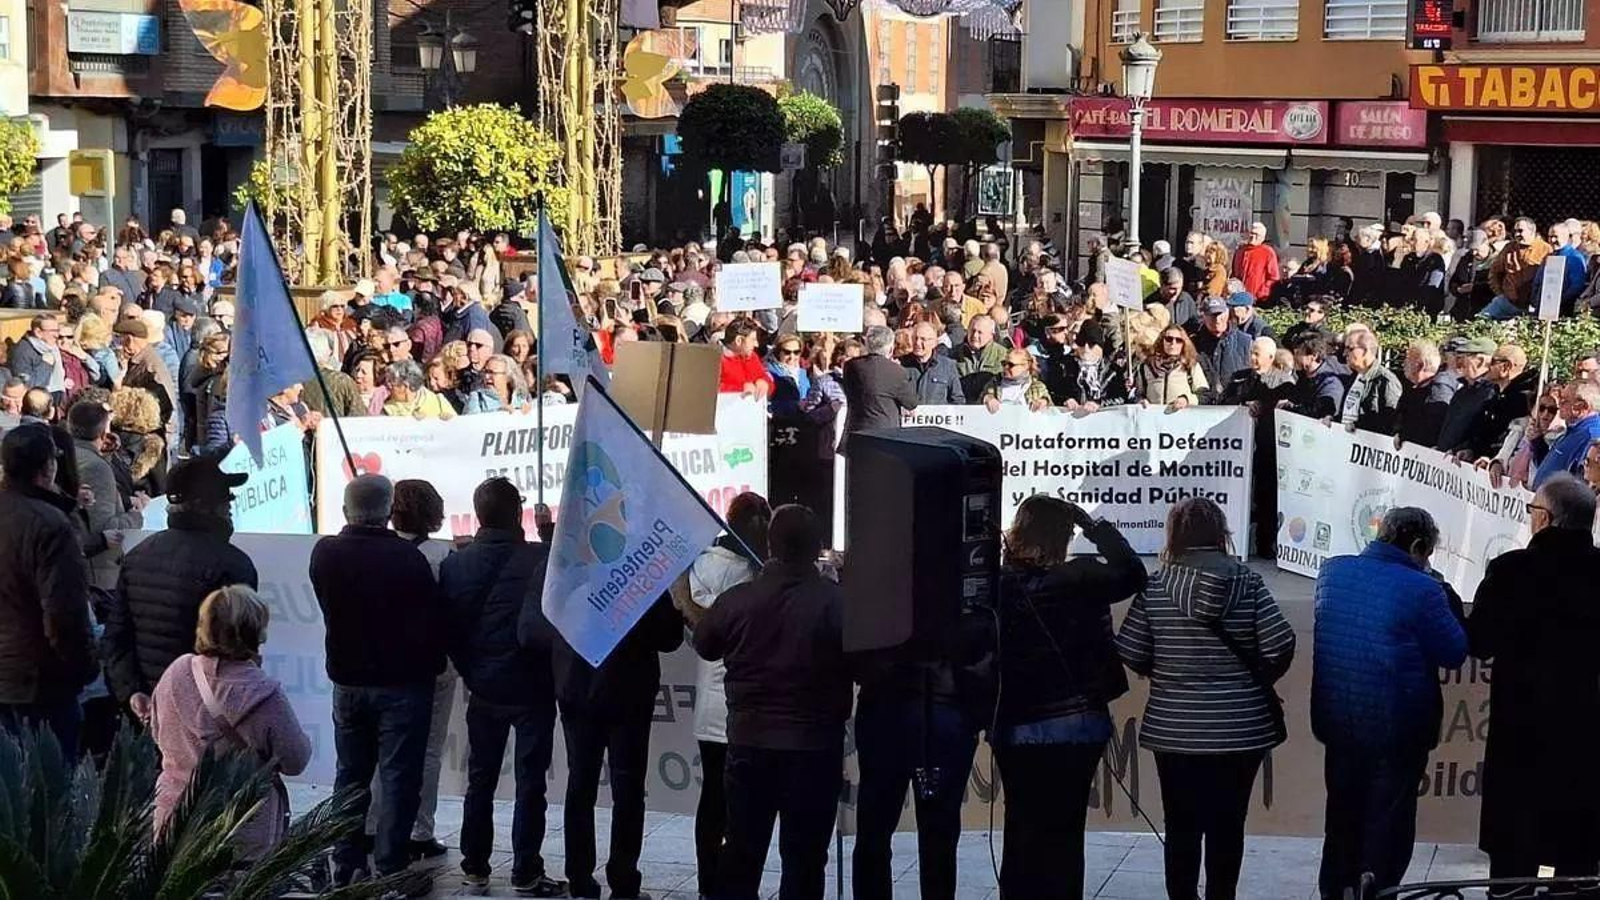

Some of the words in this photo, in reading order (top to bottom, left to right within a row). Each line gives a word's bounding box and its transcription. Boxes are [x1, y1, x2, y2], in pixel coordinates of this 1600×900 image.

[1458, 66, 1600, 109] TABAC
[1170, 107, 1279, 133] ROMERAL
[1350, 125, 1366, 139] DE
[1369, 125, 1412, 140] JUEGO
[903, 414, 953, 425] FIENDE
[481, 424, 573, 457] PLATAFOR
[1000, 432, 1120, 450] Plataforma
[1127, 437, 1152, 450] en
[1159, 432, 1243, 450] Defensa
[1033, 459, 1120, 480] Hospital
[1126, 460, 1152, 477] de
[1159, 460, 1244, 478] Montilla
[1350, 443, 1400, 474] DINERO
[1400, 453, 1444, 490] PÚBLICO
[1012, 492, 1025, 506] y
